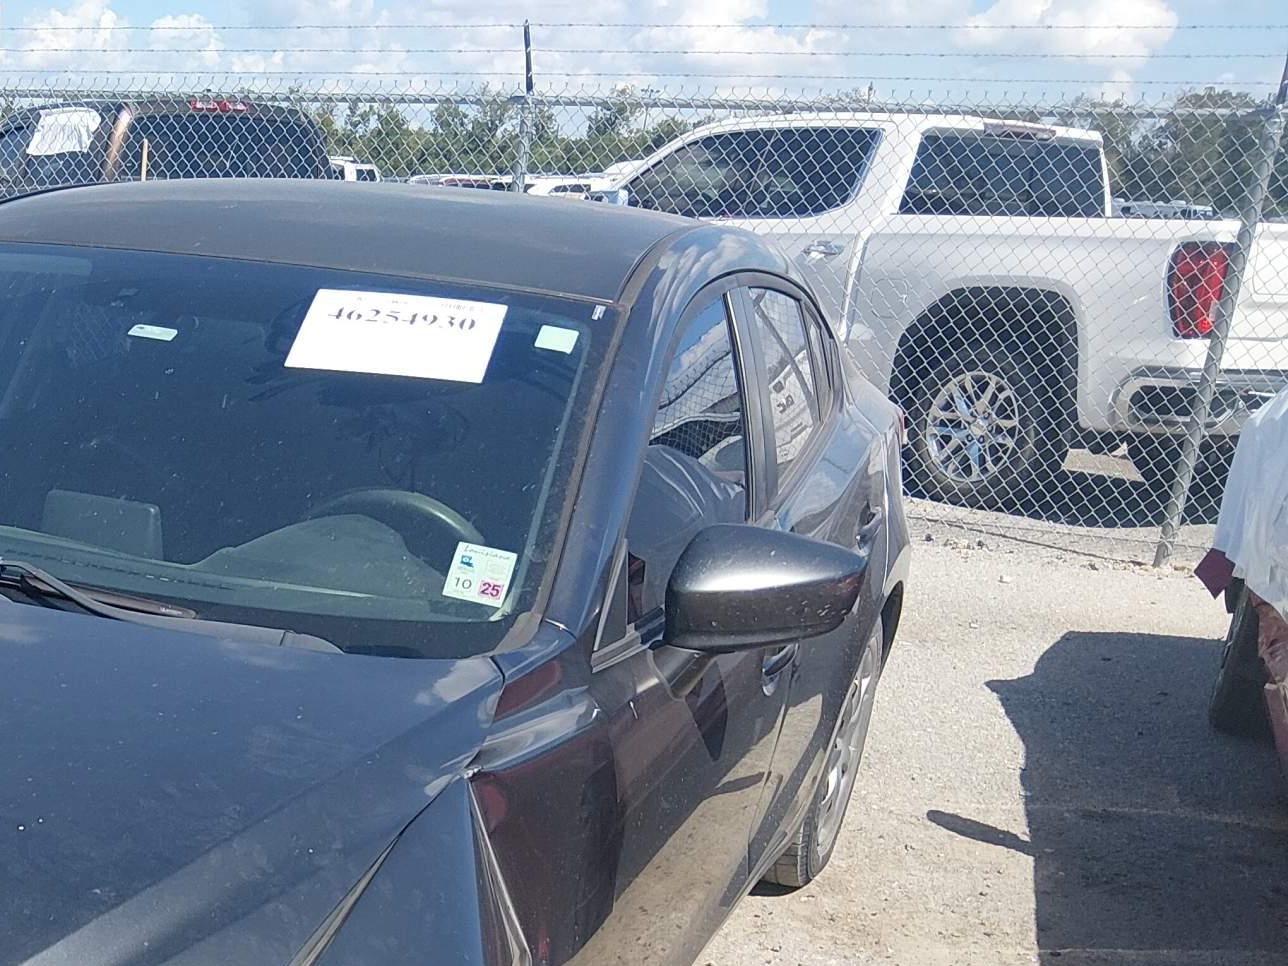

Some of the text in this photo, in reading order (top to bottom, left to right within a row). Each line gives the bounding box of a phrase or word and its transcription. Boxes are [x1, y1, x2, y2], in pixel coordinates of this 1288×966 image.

[327, 306, 477, 331] 46254930
[455, 577, 502, 598] 10 25
